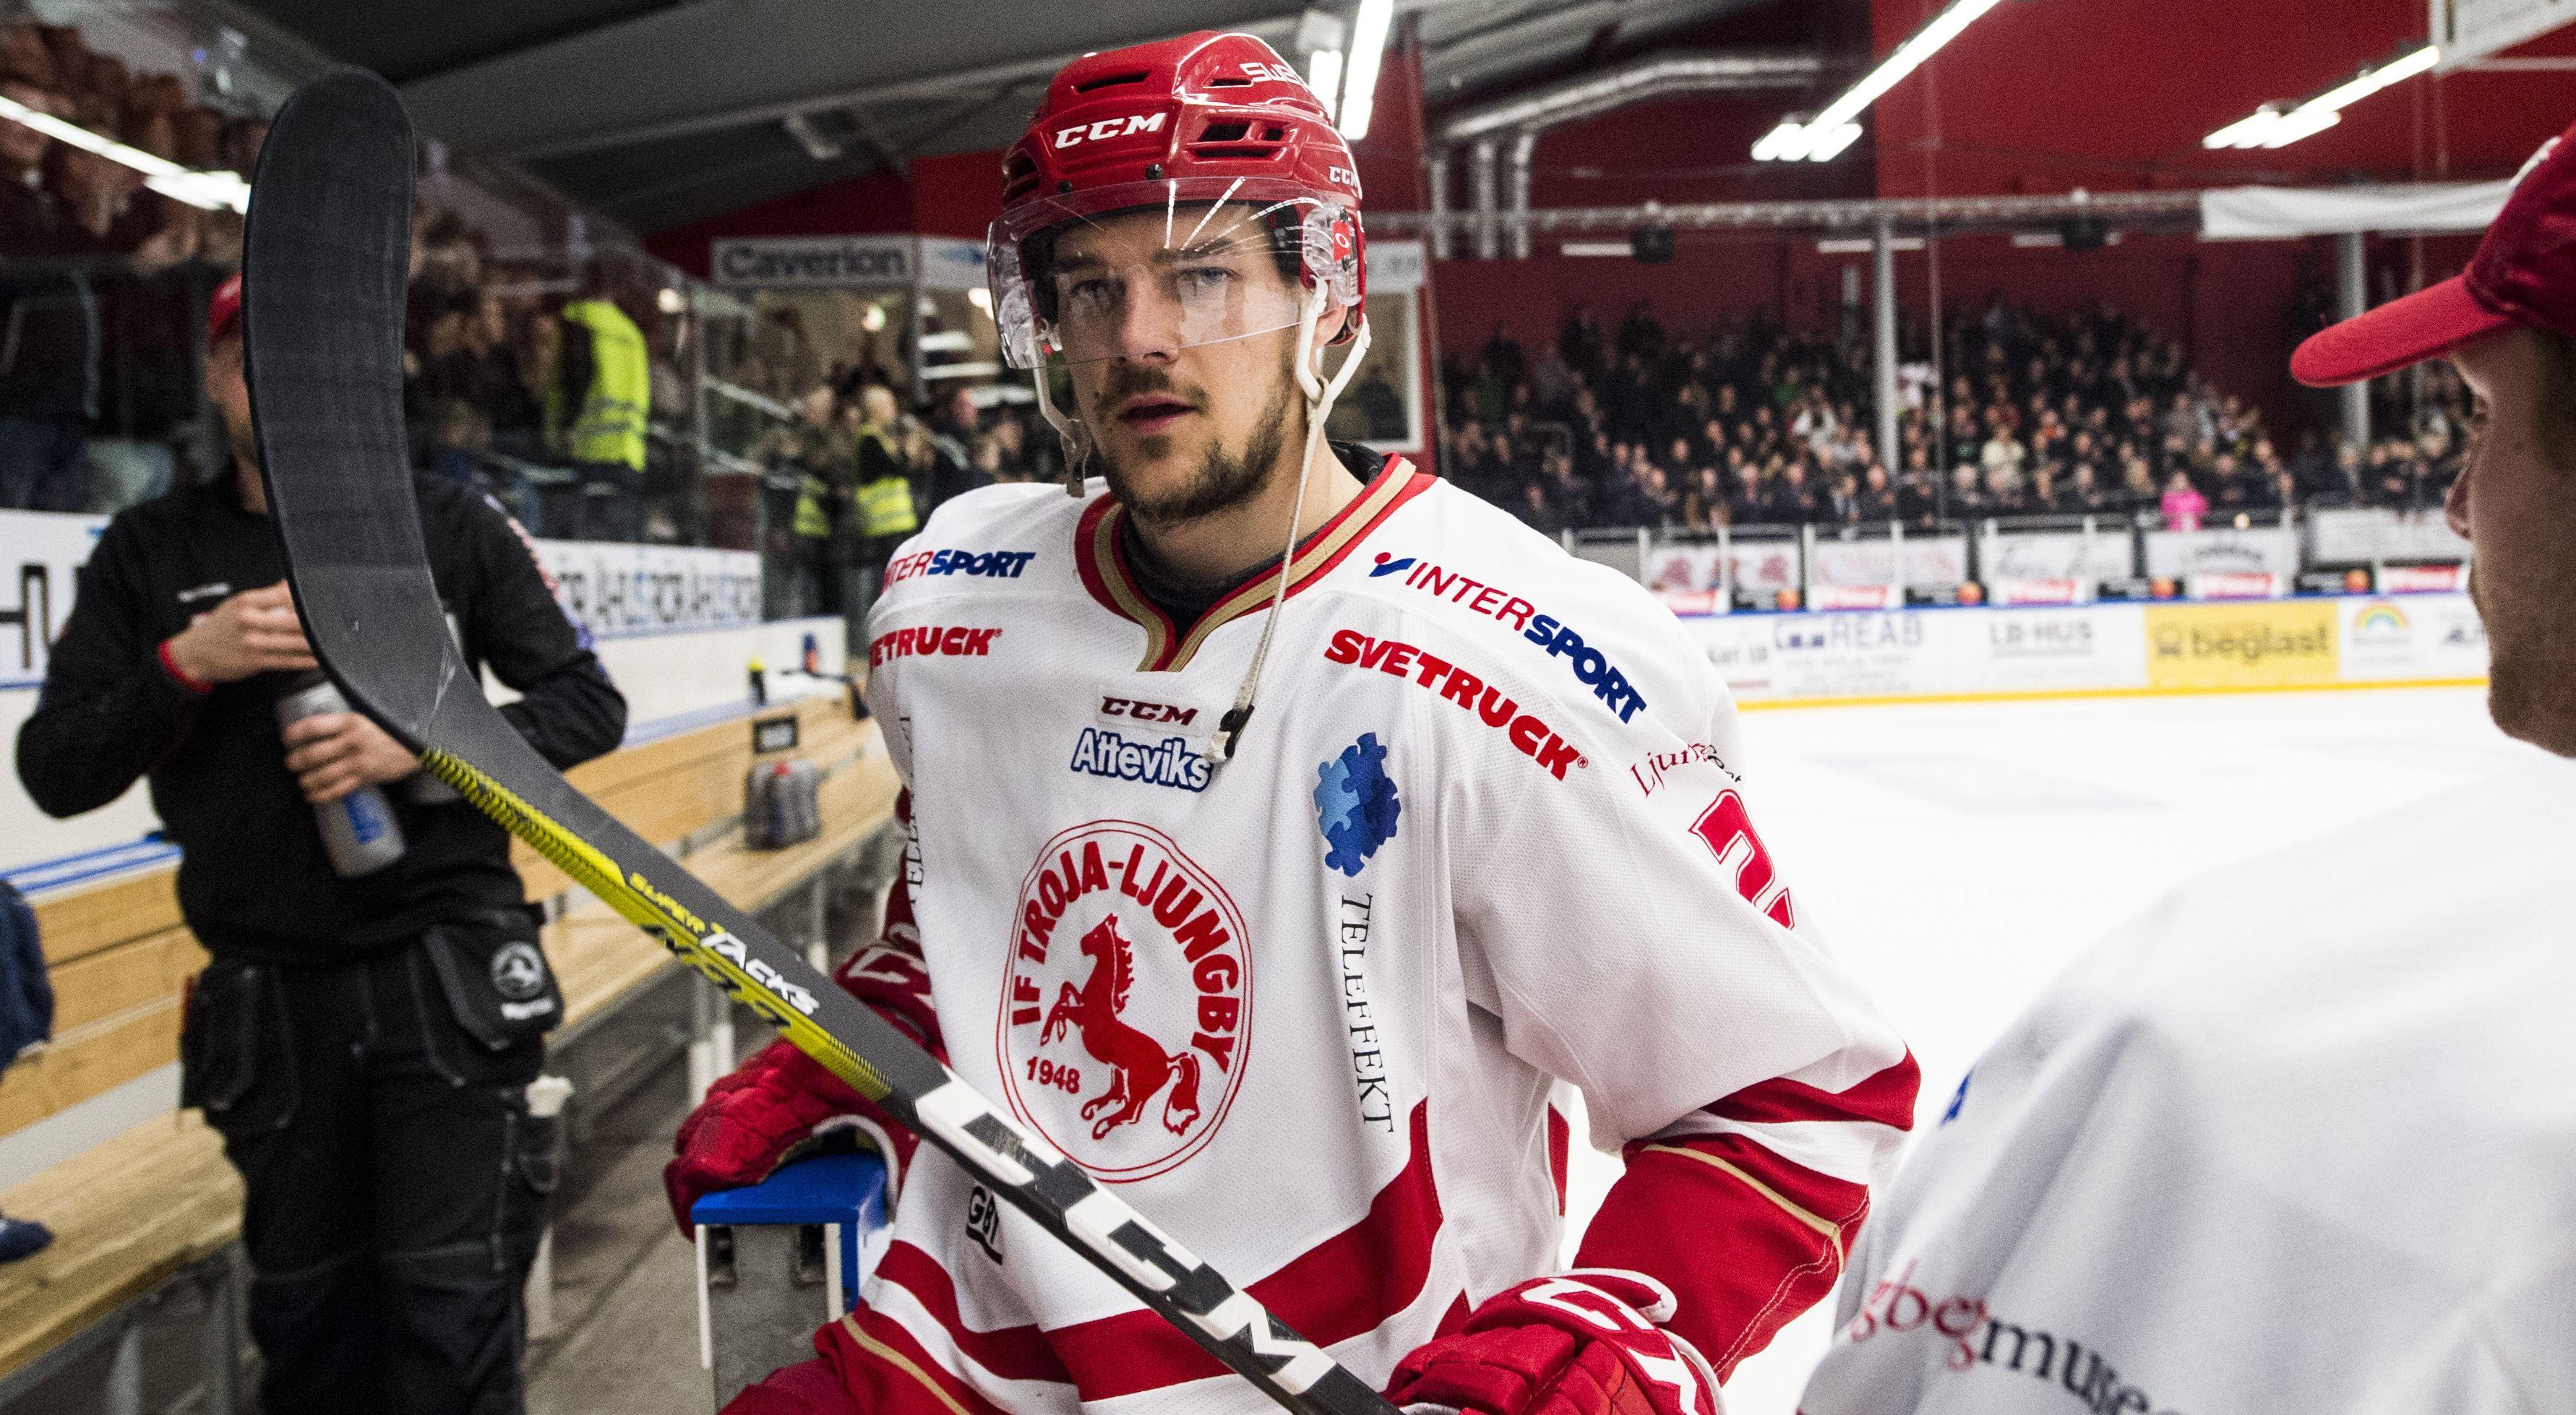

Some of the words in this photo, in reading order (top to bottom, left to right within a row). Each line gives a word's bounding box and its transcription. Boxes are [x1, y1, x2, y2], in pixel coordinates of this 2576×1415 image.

[1055, 111, 1167, 149] CCM
[881, 549, 1036, 594] TERSPORT
[1405, 561, 1647, 724] INTERSPORT
[1102, 695, 1199, 726] CCM
[1070, 728, 1215, 793] Atteviks
[1018, 840, 1240, 1075] TROJA-LJUNGBY
[1012, 976, 1042, 1026] IF
[1341, 892, 1395, 1133] TELEFFEKT
[1026, 1056, 1081, 1094] 1948
[915, 1068, 1339, 1396] CCM
